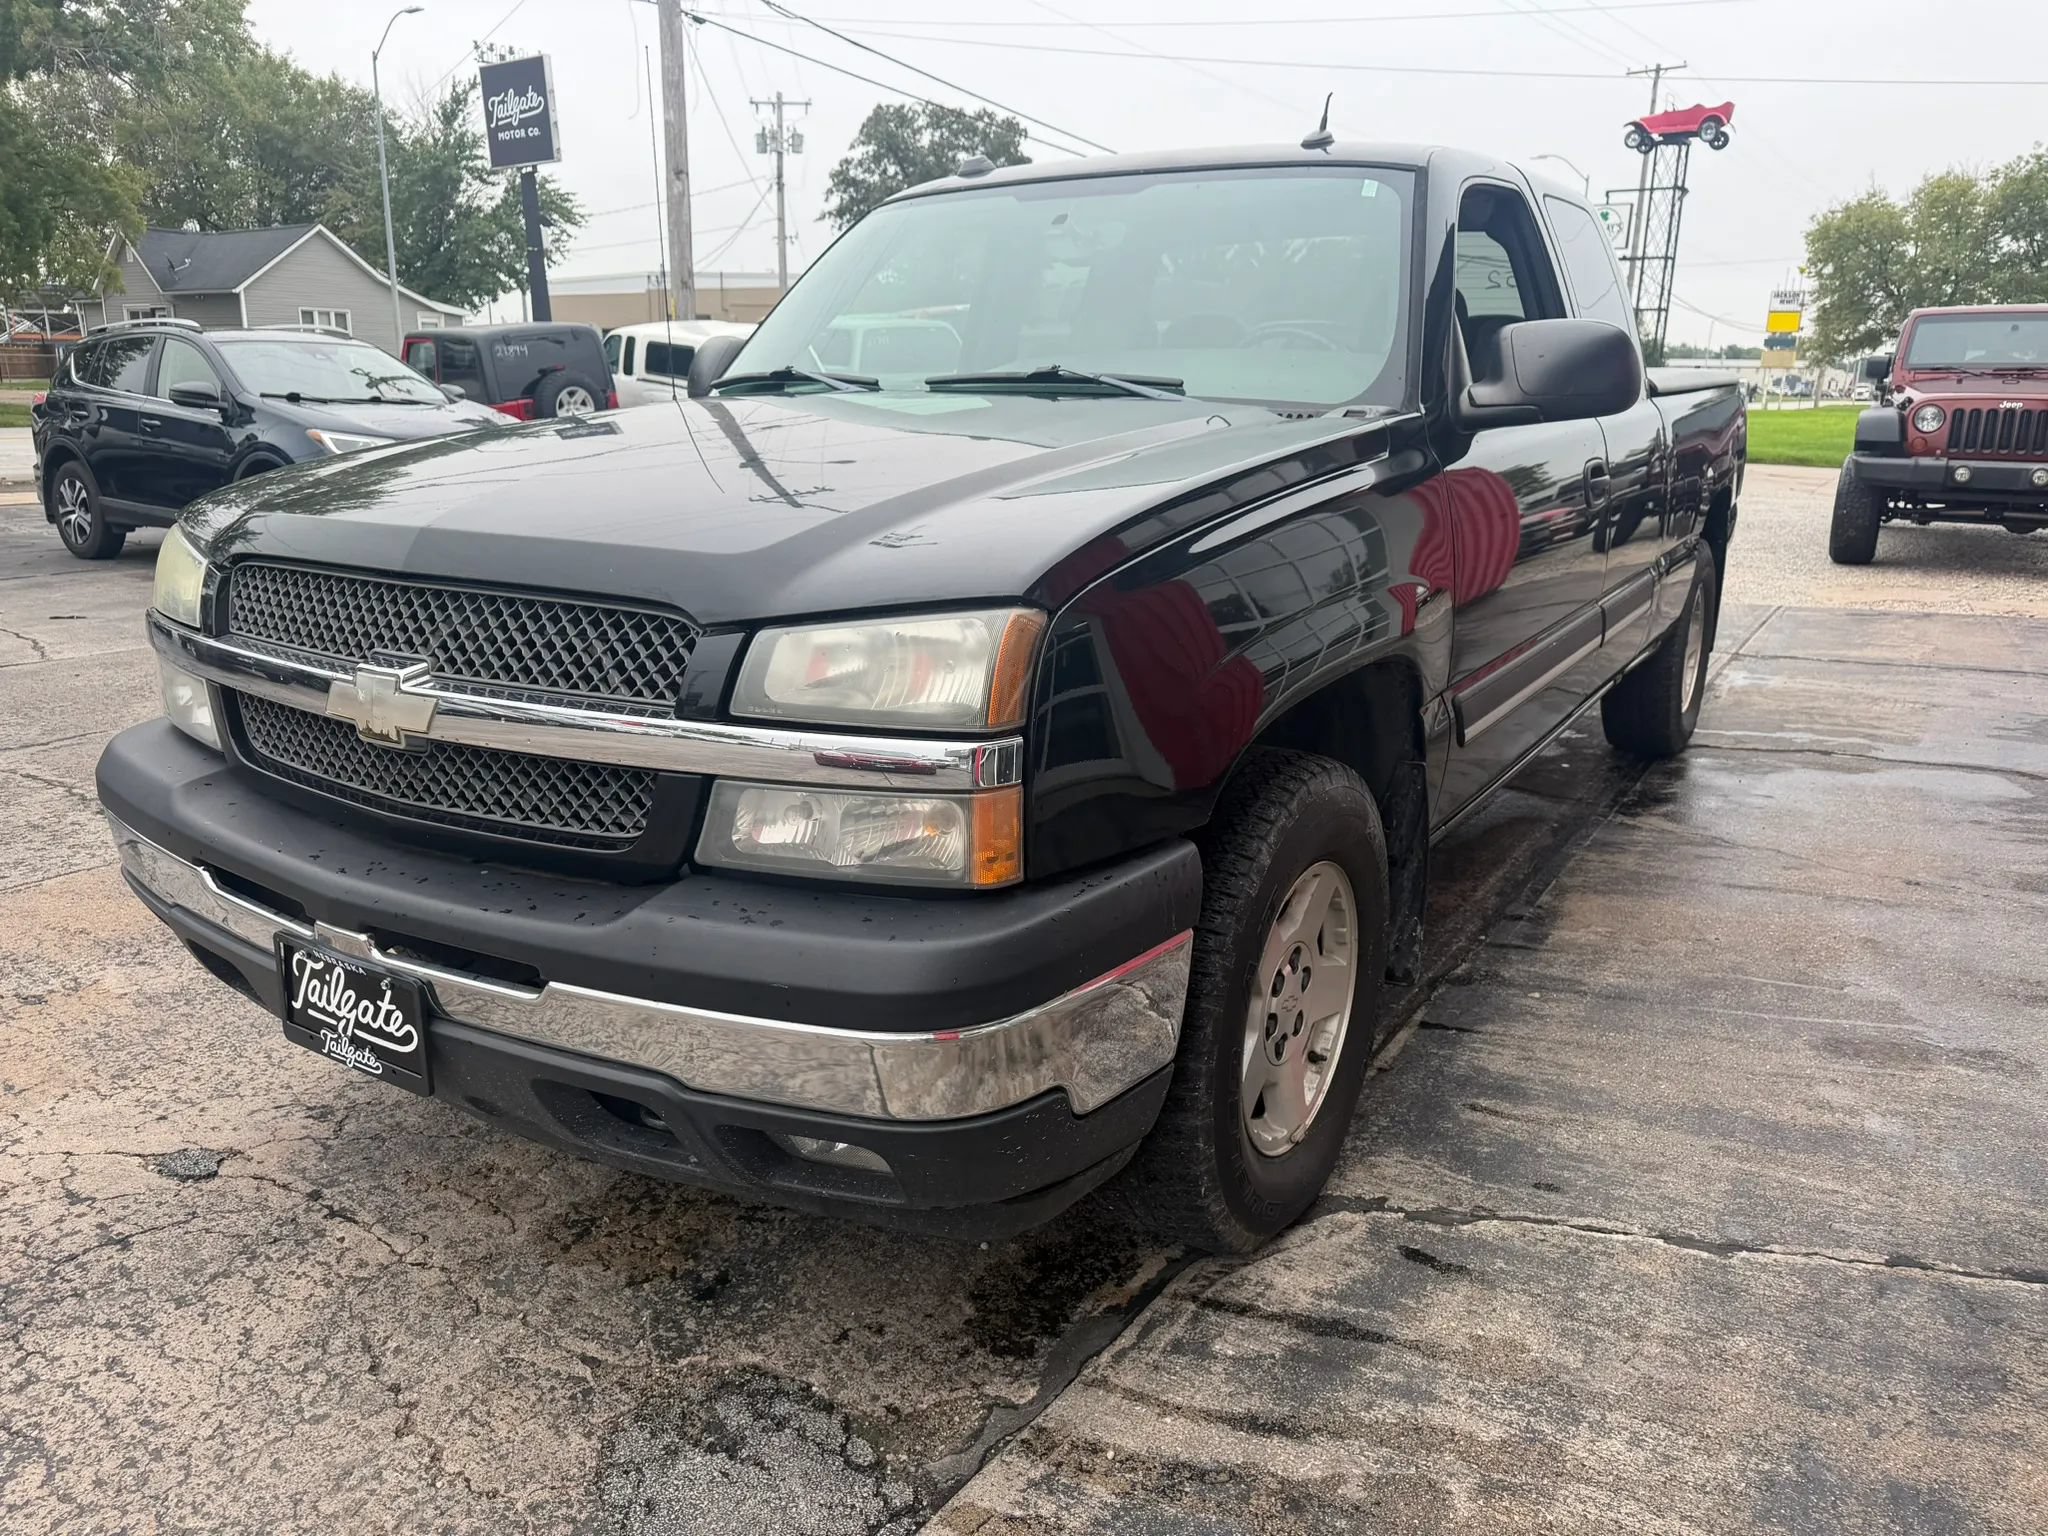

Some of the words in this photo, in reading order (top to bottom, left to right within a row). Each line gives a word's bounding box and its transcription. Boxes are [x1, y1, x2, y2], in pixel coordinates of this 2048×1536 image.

[488, 85, 545, 128] Tailgate
[498, 128, 526, 140] MOTOR
[527, 127, 541, 137] CO.
[1999, 400, 2024, 410] Jeep
[312, 949, 367, 976] NEBRASKA
[292, 950, 419, 1053] Tailgate
[320, 1028, 383, 1075] Tailgate
